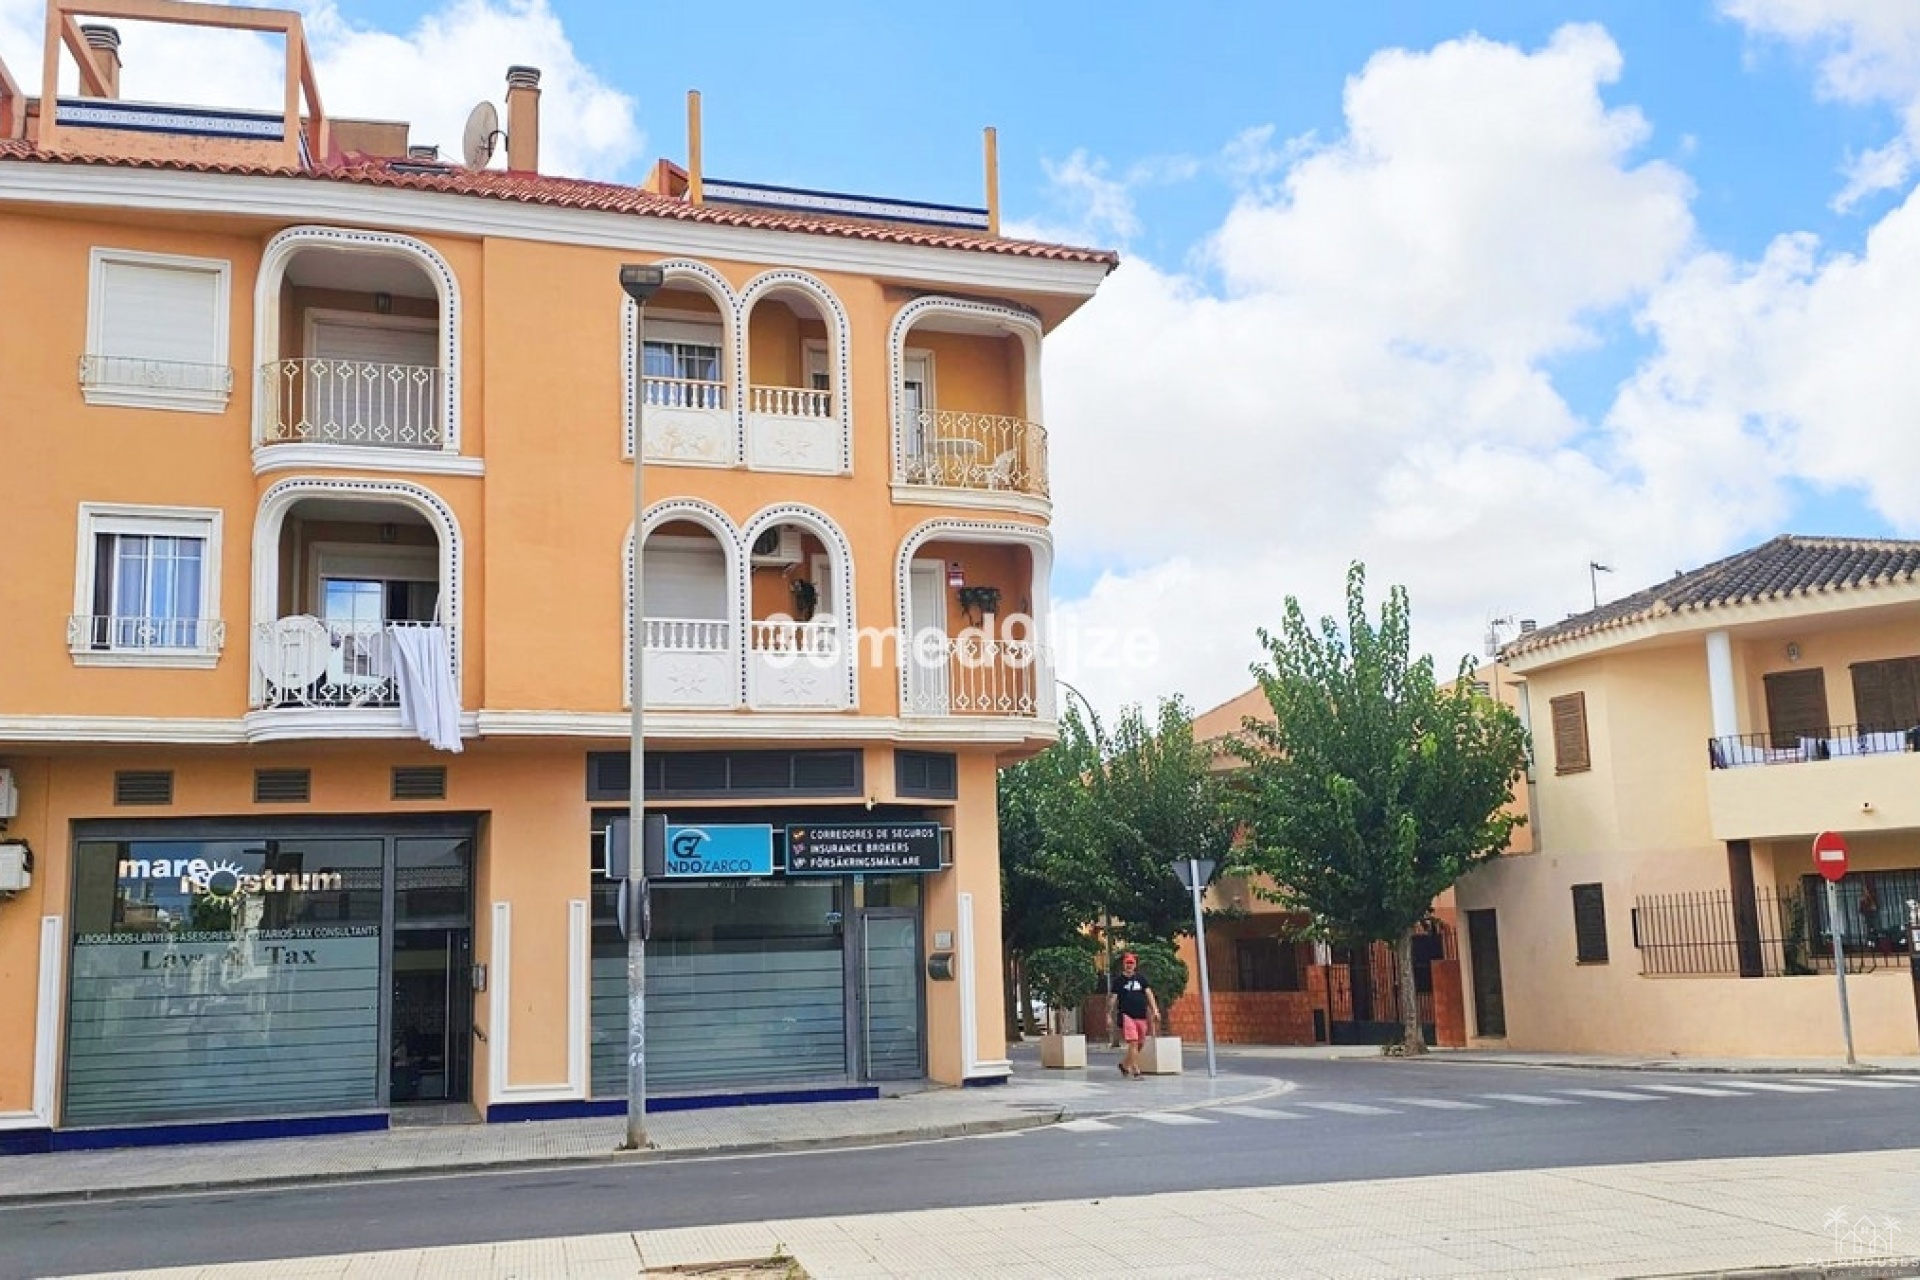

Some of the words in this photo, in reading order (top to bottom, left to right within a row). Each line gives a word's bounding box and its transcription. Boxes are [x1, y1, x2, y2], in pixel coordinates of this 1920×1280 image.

[810, 828, 873, 840] CORREDORES
[876, 828, 888, 840] DE
[891, 827, 935, 839] SEGUROS
[809, 842, 863, 854] INSURANCE
[866, 841, 910, 853] BROKERS
[118, 857, 209, 881] mare
[667, 859, 752, 873] NDOZARCO
[264, 945, 317, 965] Tax
